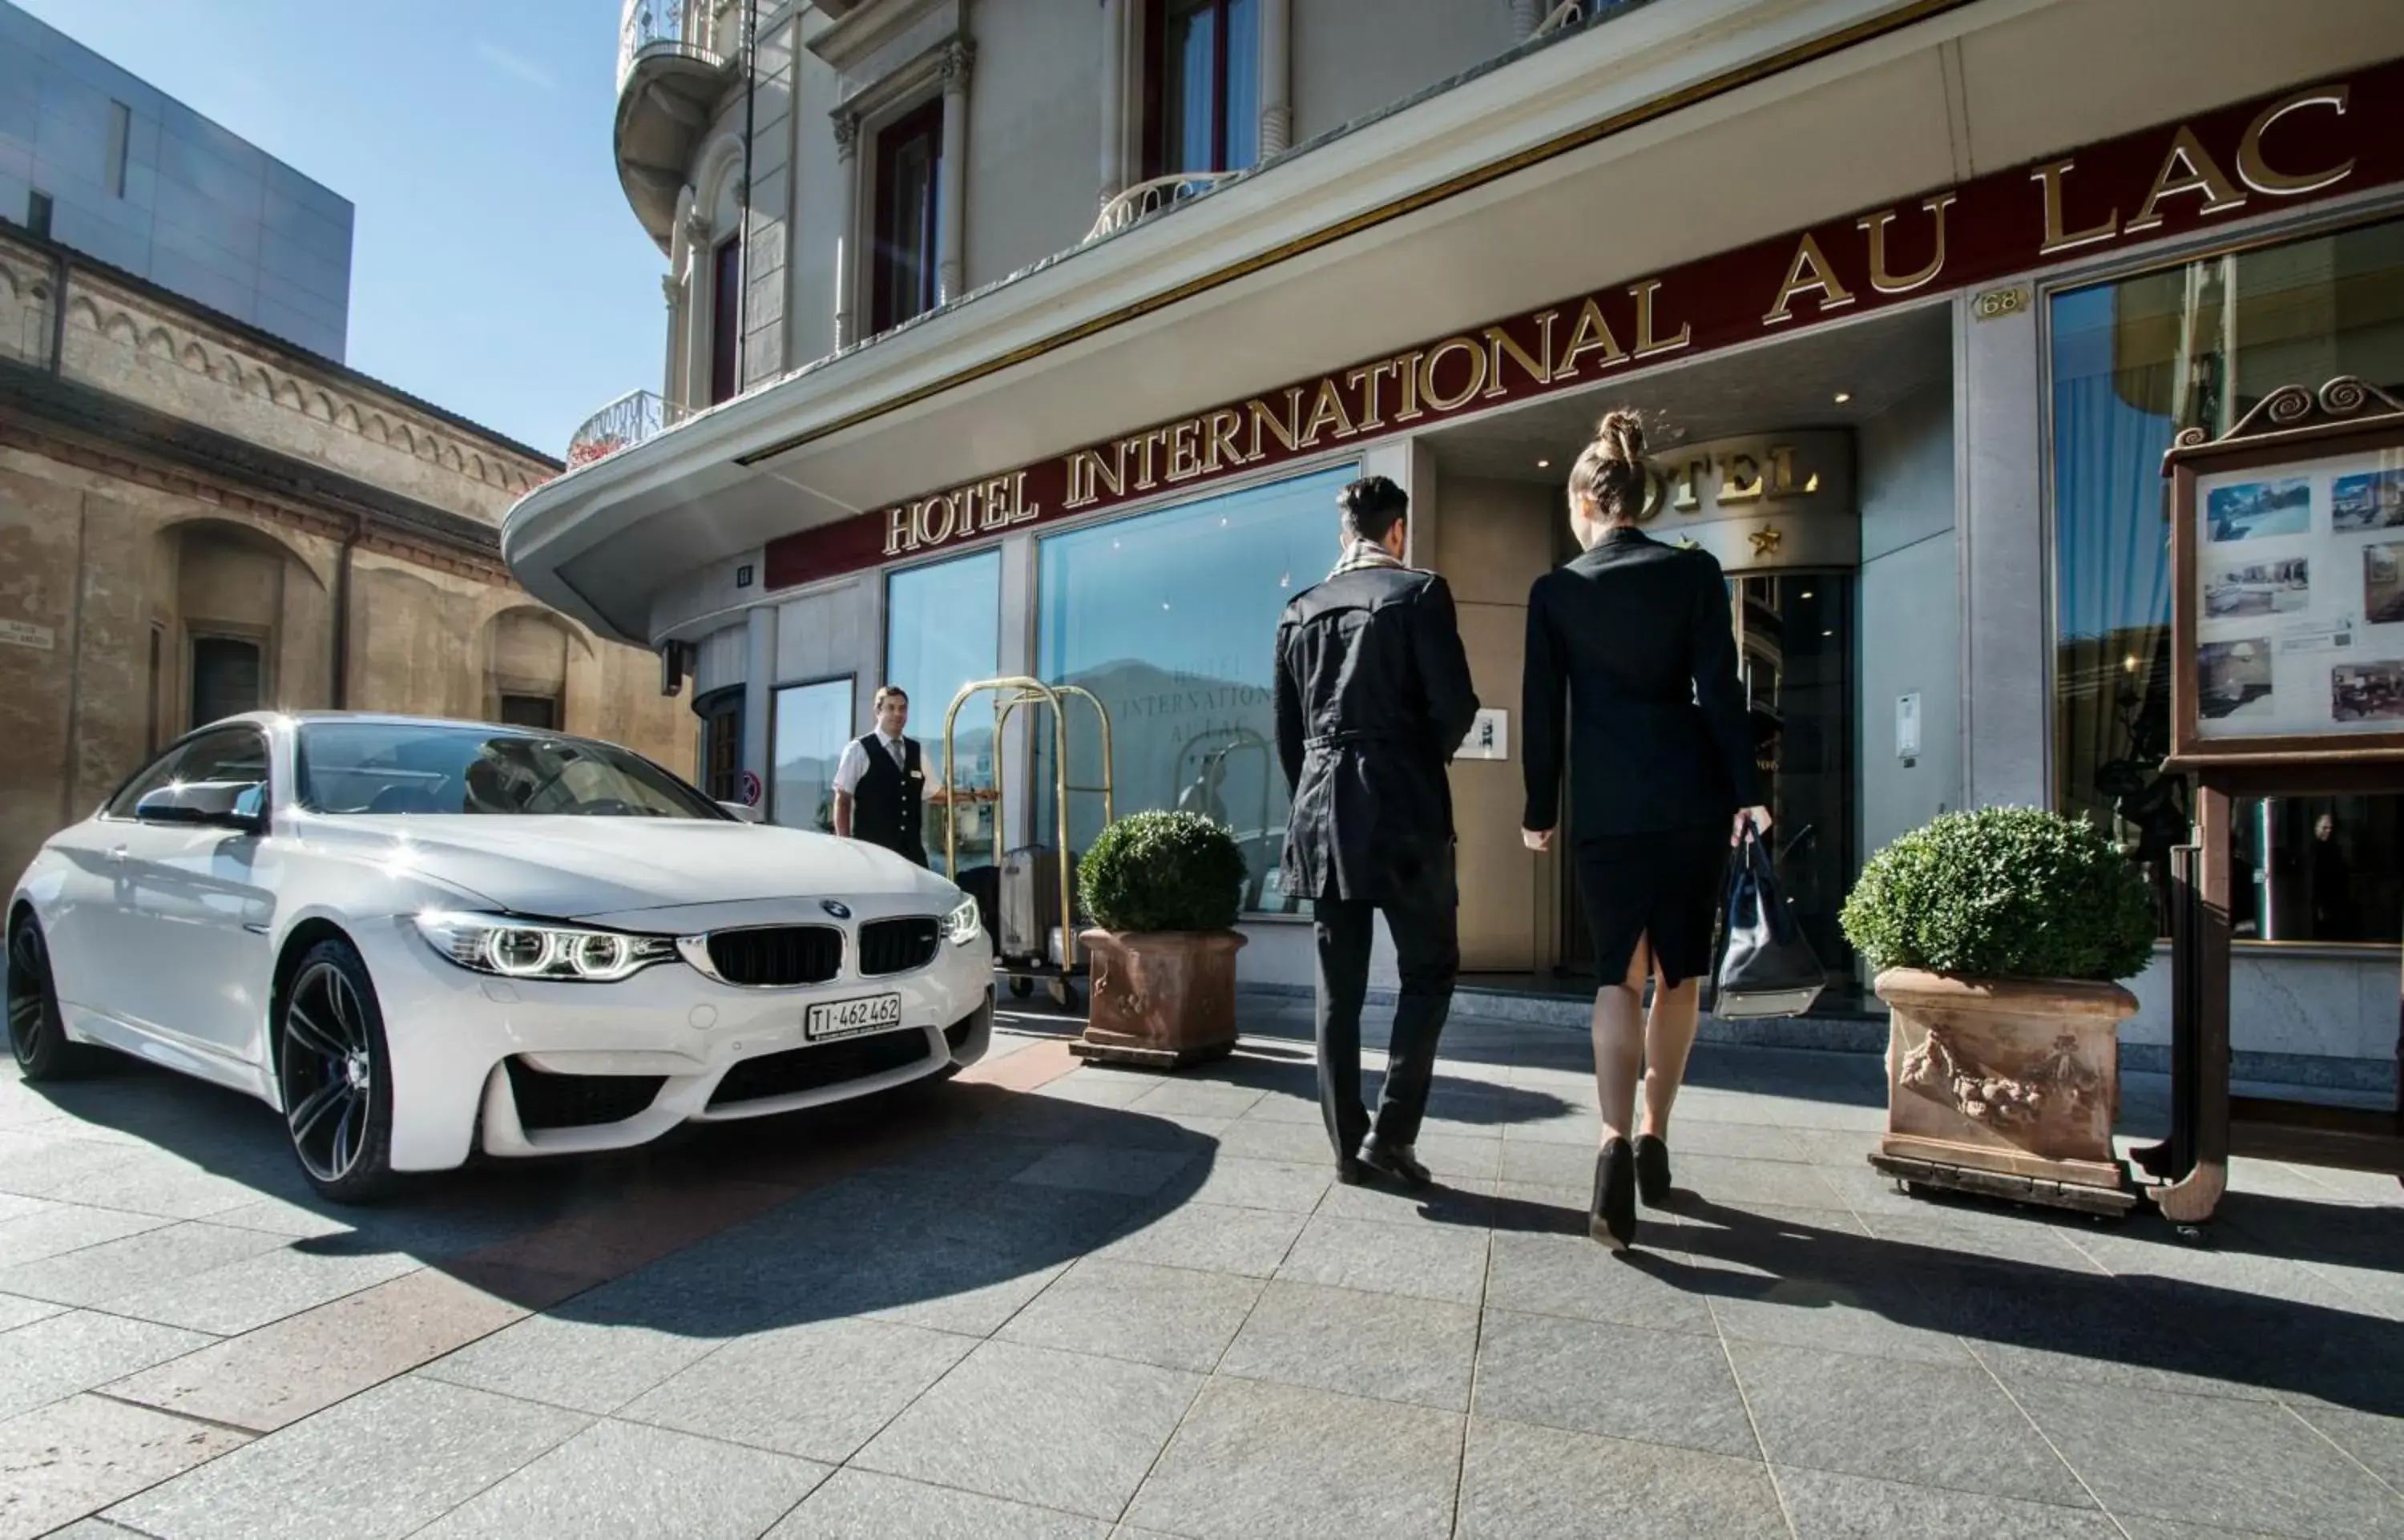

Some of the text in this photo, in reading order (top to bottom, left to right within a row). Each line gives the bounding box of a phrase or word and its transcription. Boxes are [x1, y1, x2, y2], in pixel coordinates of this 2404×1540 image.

[882, 83, 2357, 555] HOTEL INTERNATIONAL AU LAC
[1983, 289, 2018, 314] 68
[1640, 445, 1819, 521] TEL
